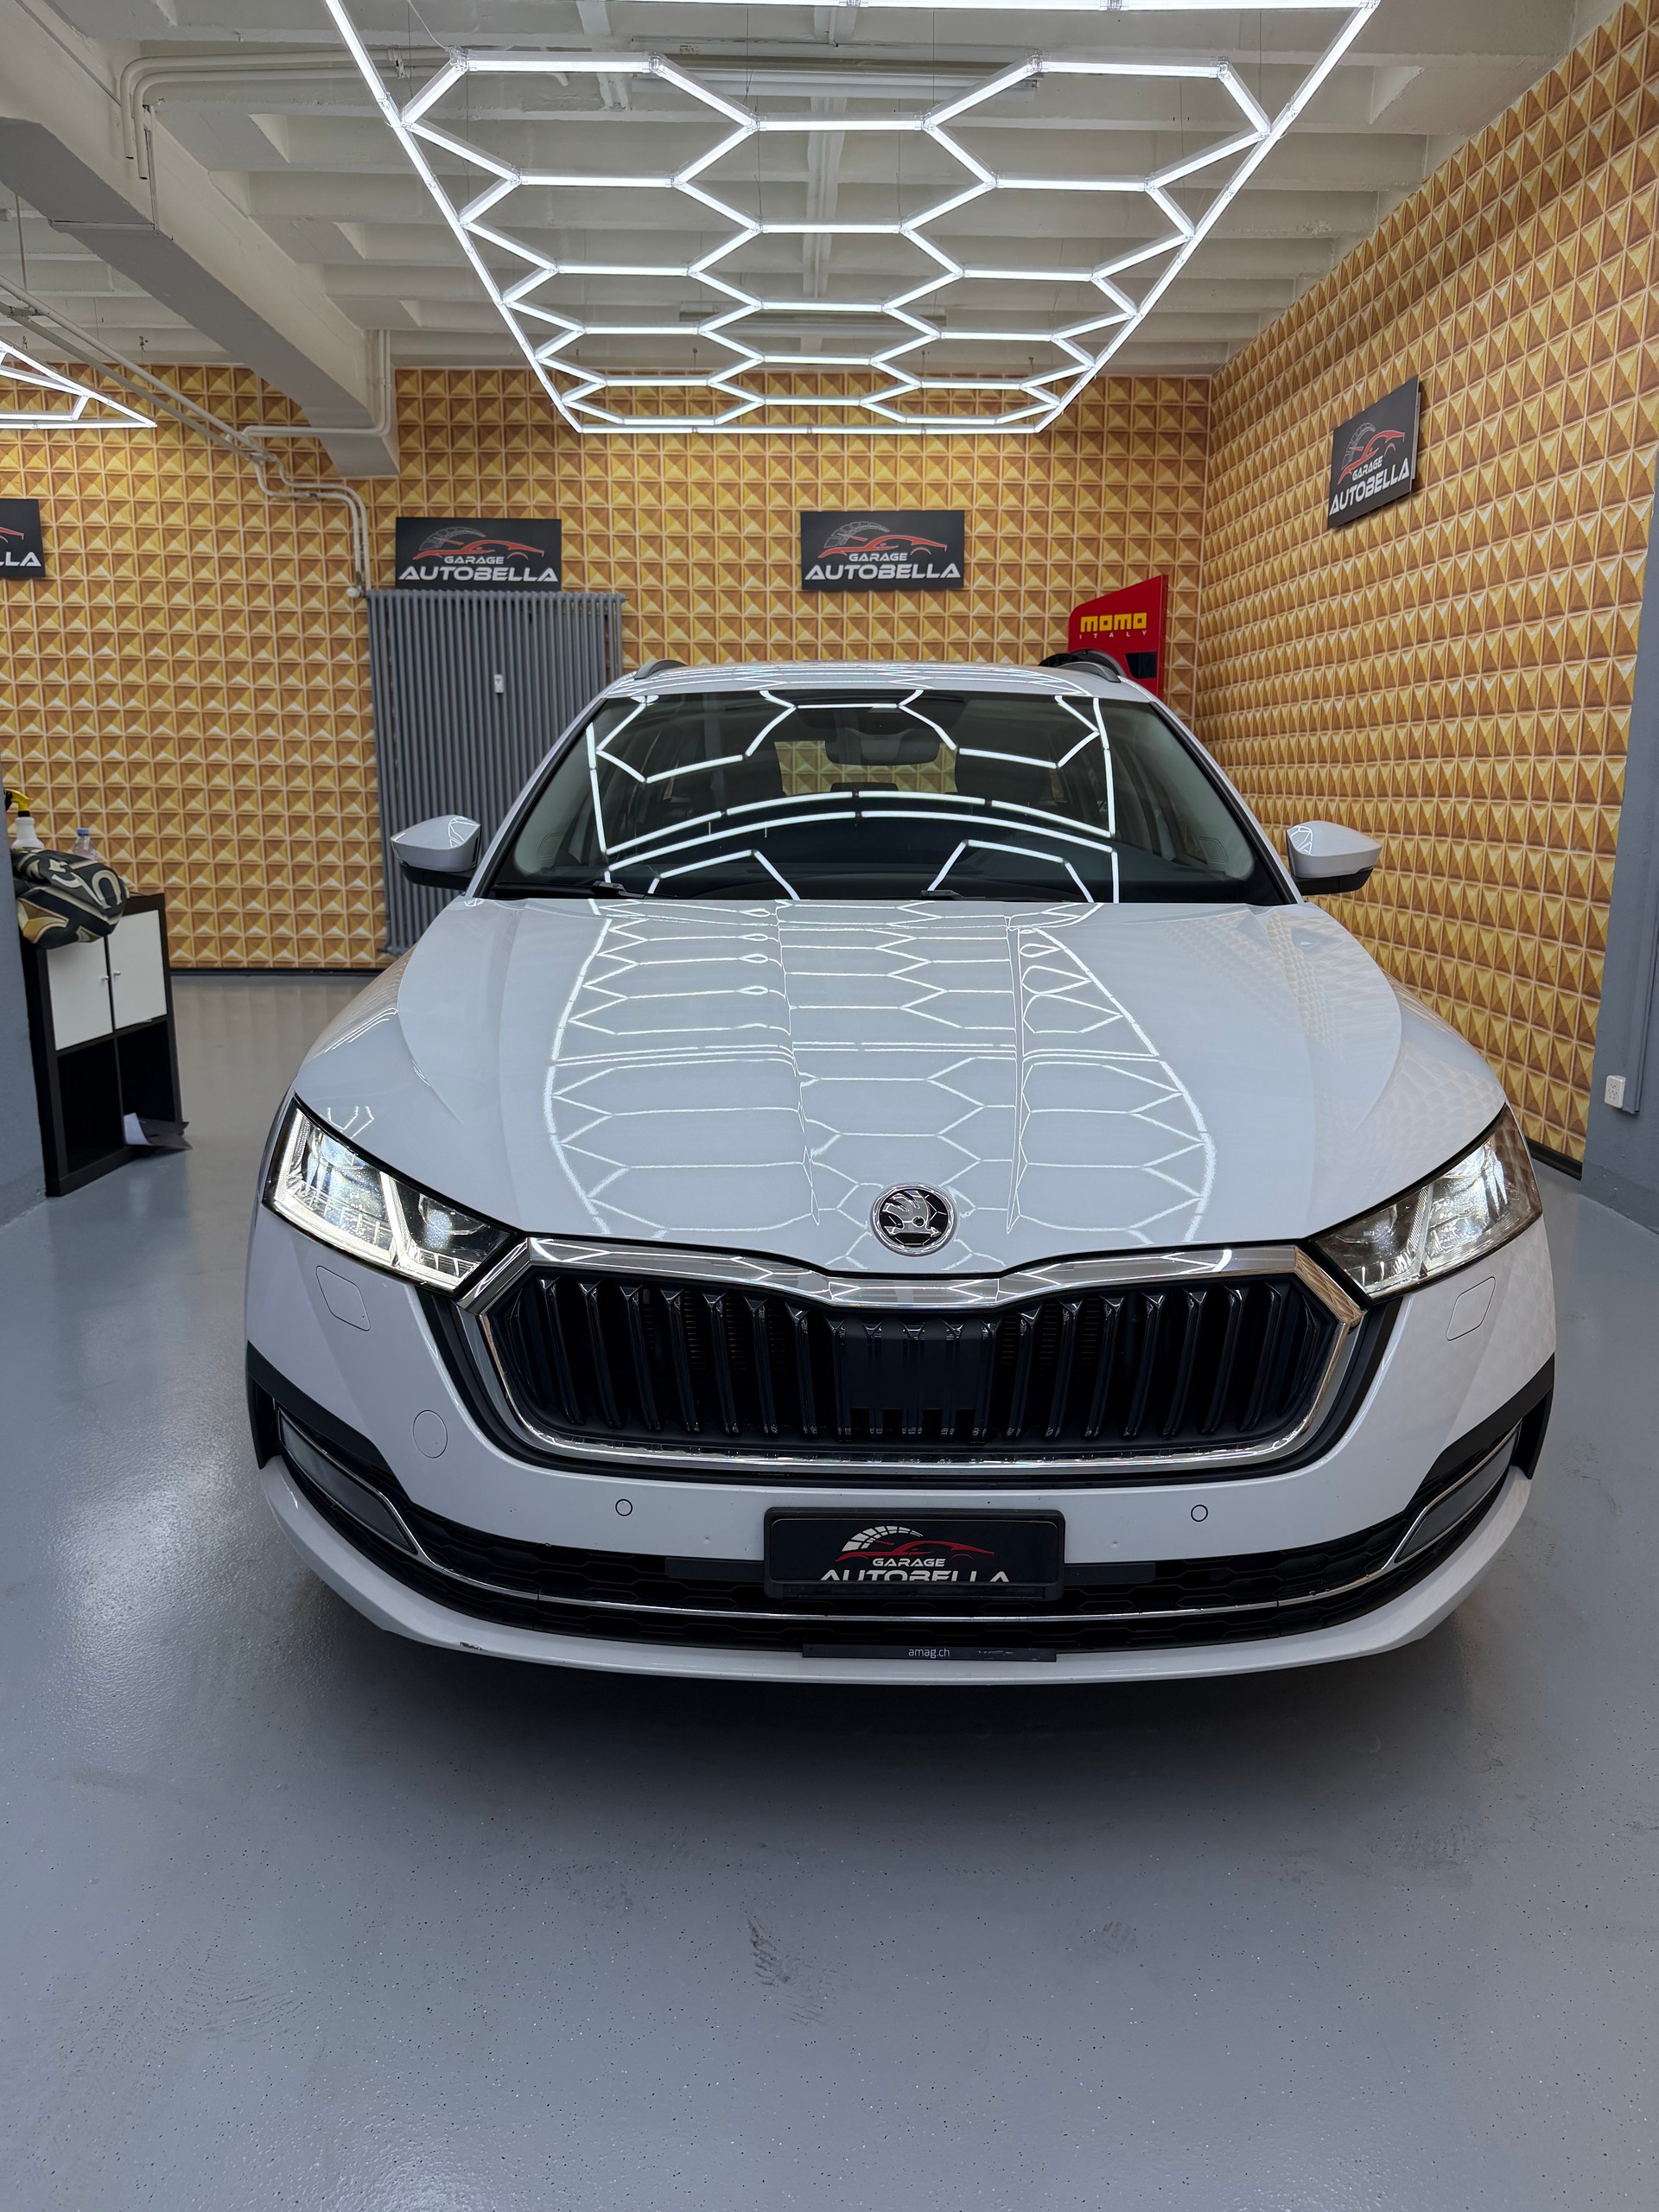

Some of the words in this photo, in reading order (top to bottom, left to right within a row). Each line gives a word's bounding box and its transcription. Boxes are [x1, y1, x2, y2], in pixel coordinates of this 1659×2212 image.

[1352, 454, 1383, 481] GARAGE
[1329, 457, 1410, 516] AUTOBELLA
[443, 556, 505, 565] GARAGE
[849, 552, 908, 563] GARAGE
[398, 565, 558, 582] AUTOBELLA
[804, 563, 961, 581] AUTOBELLA
[1079, 630, 1147, 639] ITALY
[872, 1558, 946, 1567] GARAGE
[908, 1648, 950, 1658] amag.ch
